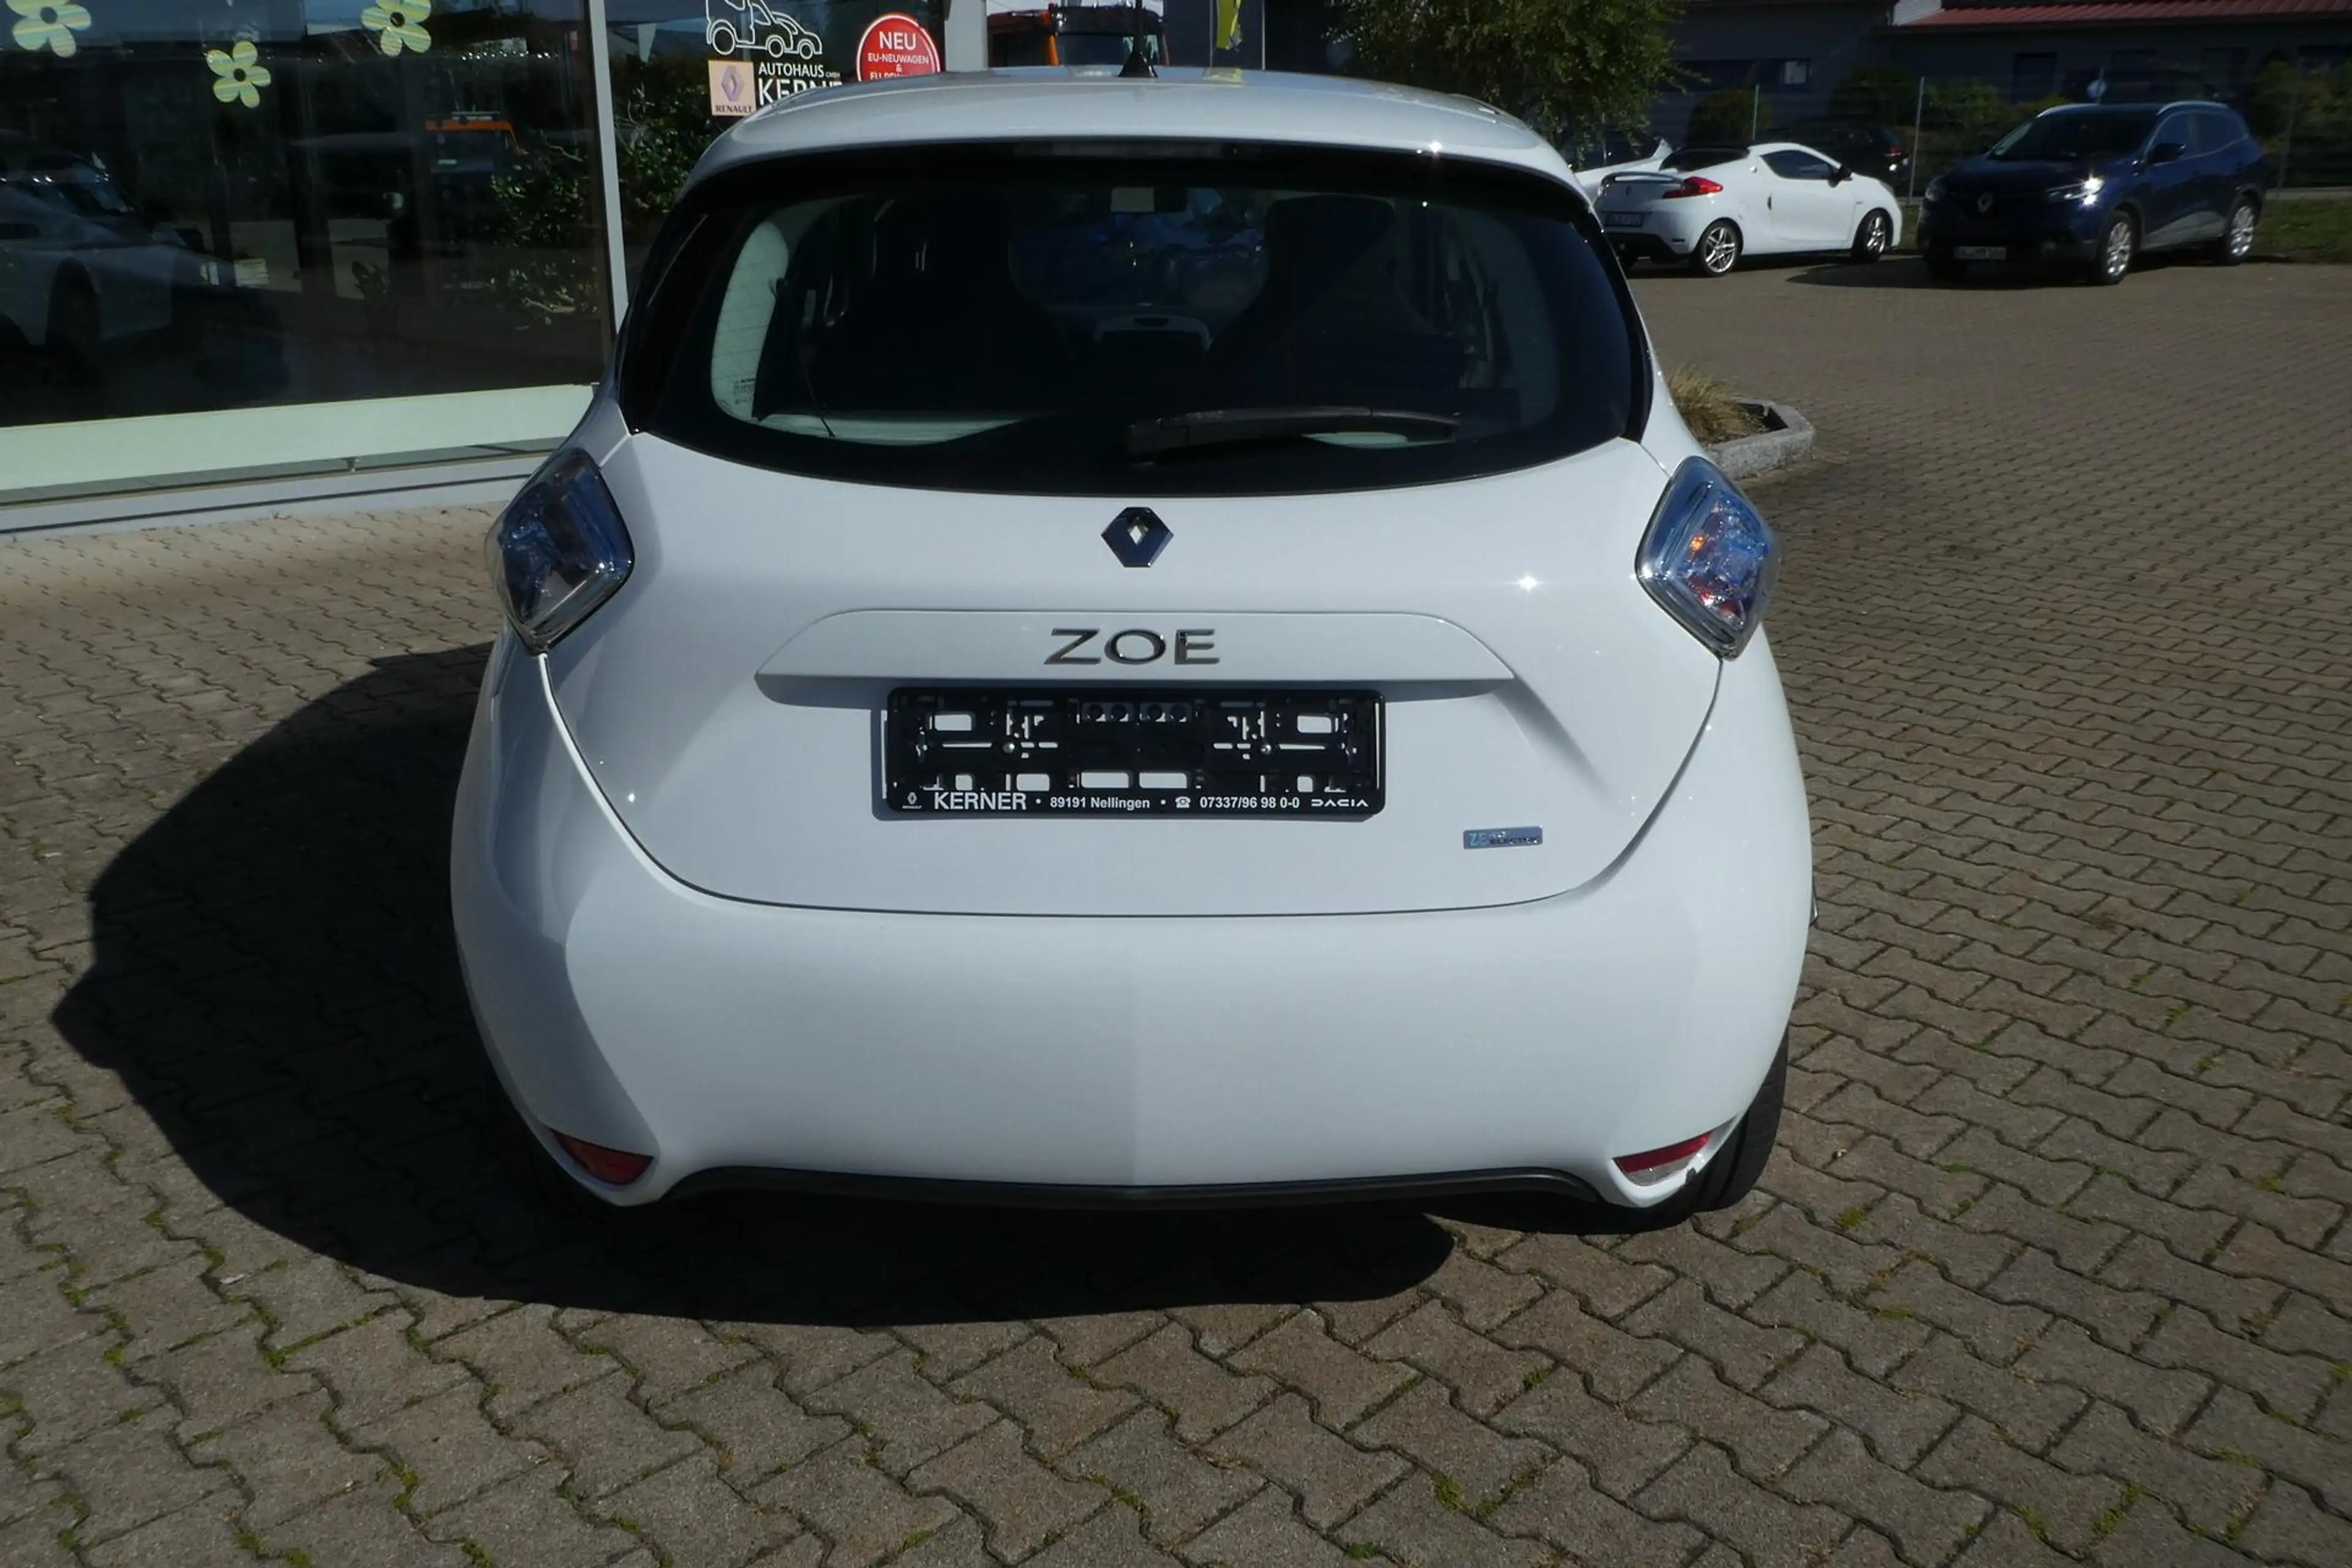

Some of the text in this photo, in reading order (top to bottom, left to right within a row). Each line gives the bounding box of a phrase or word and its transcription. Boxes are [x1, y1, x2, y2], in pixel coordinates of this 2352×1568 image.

[879, 31, 916, 50] NEU
[867, 53, 929, 64] EU-NEUWAGEN
[758, 62, 824, 78] AUTOHAUS
[1043, 628, 1220, 665] ZOE
[934, 792, 1300, 811] KERNER 89191 Nellingen 07337/96 98 0-0
[1311, 799, 1369, 807] DACIA
